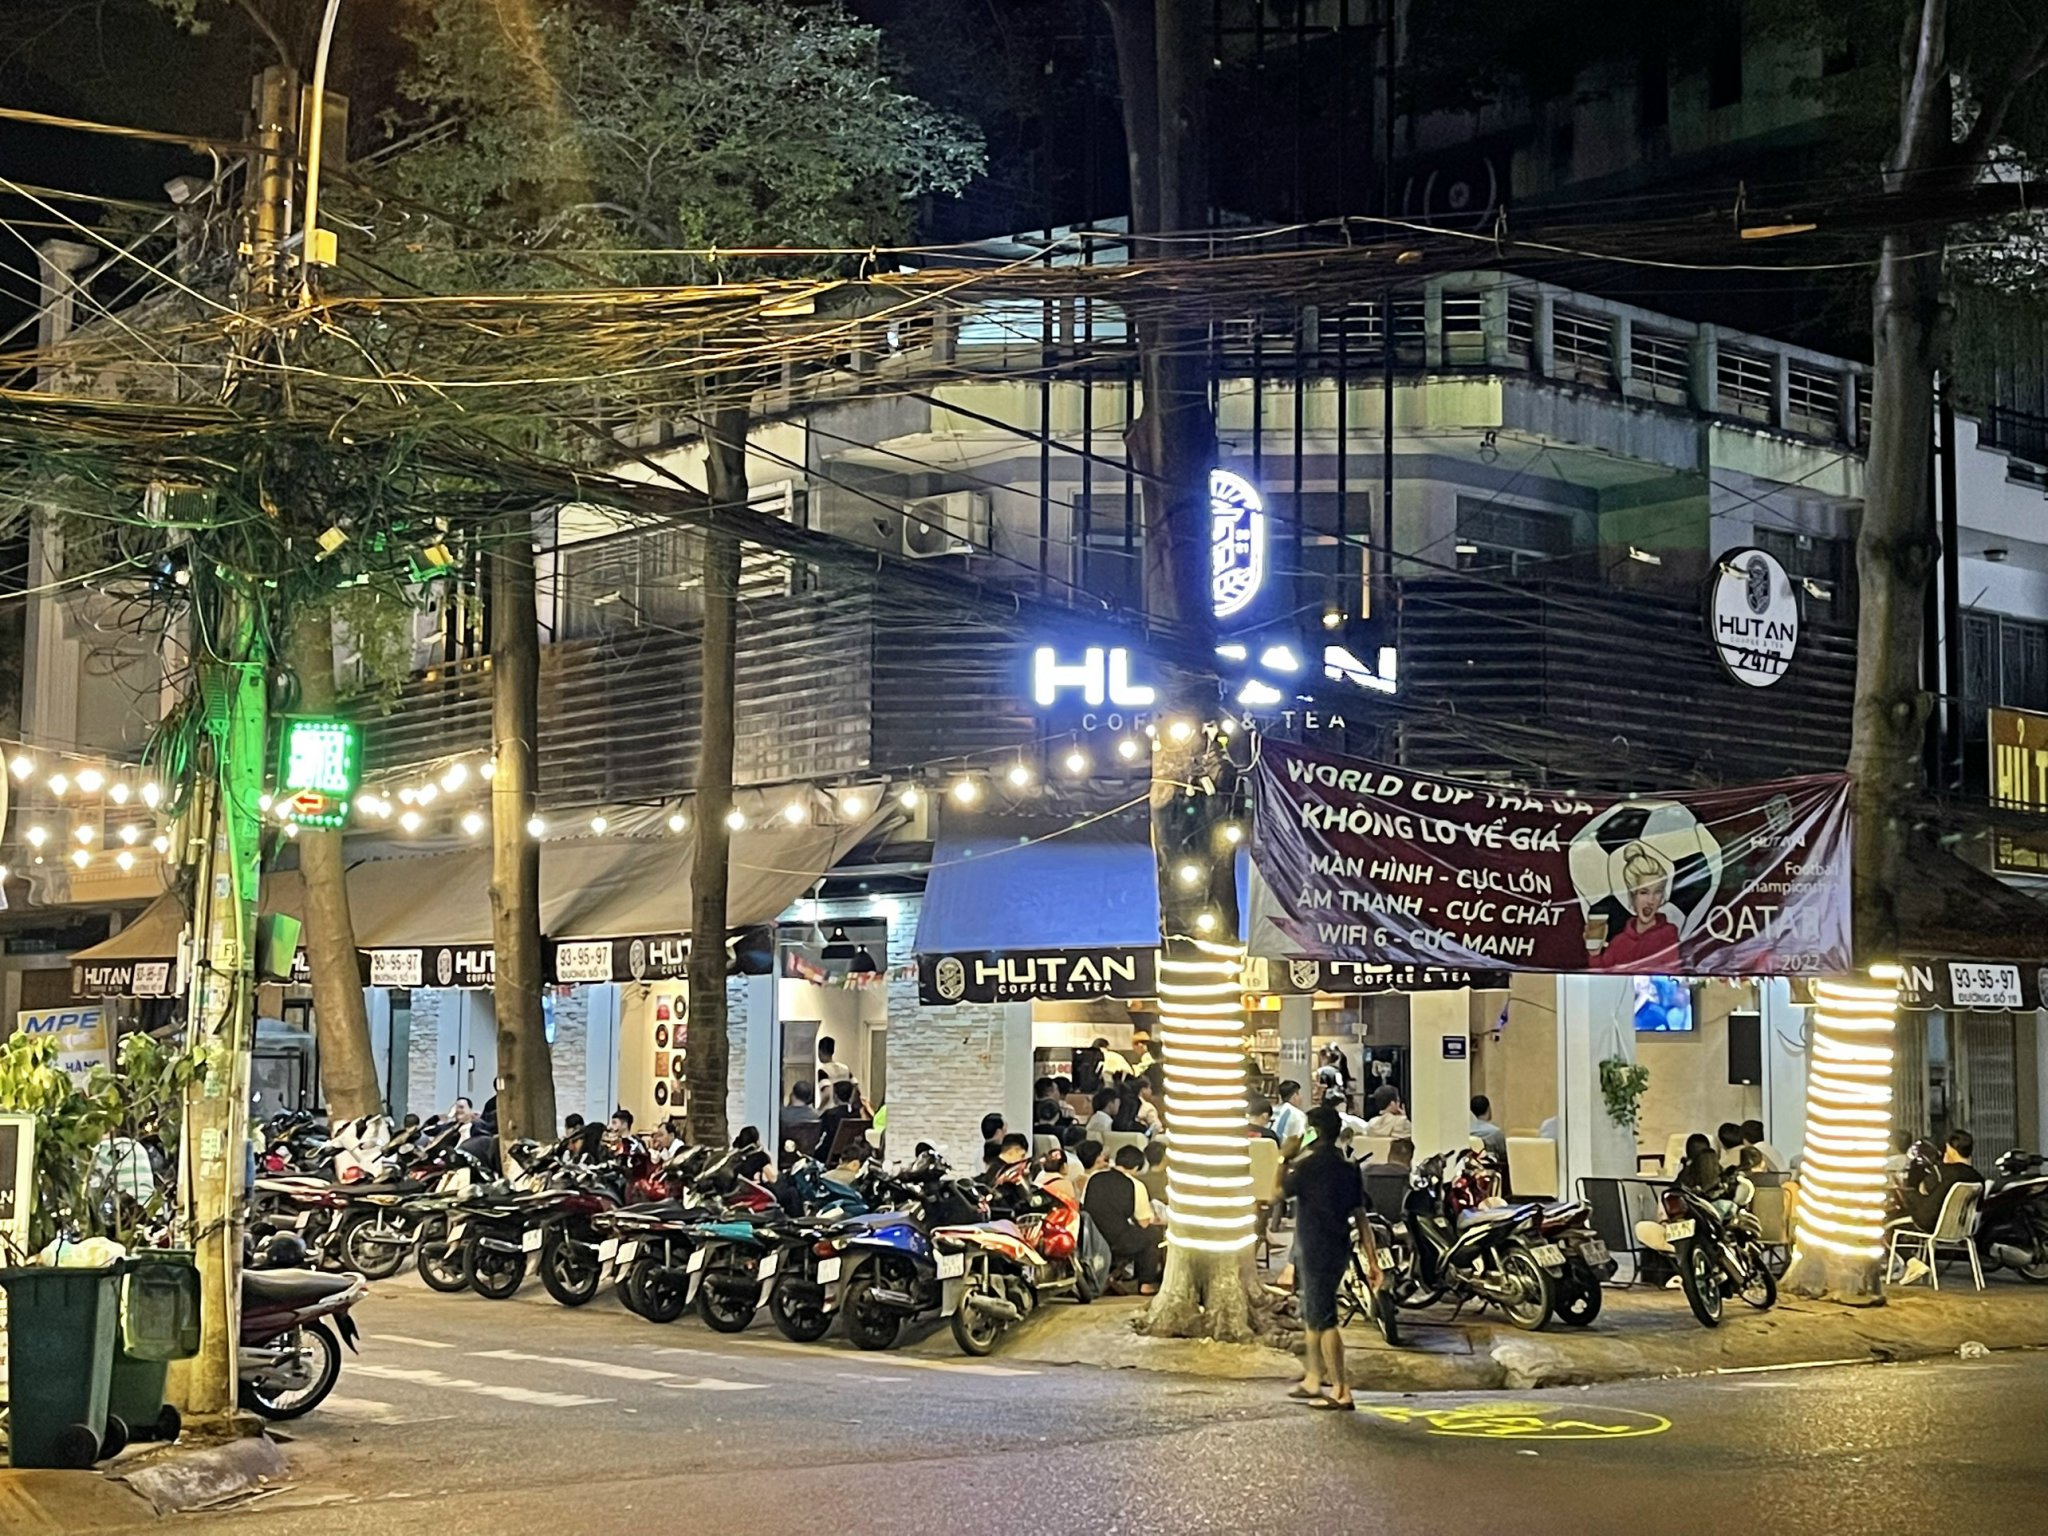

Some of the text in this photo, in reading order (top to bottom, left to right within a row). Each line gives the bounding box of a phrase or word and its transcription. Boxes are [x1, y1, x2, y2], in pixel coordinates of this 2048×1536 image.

[1718, 615, 1794, 642] HUTAN
[1281, 711, 1346, 730] TEA
[1286, 757, 1404, 797] WORLD
[1411, 781, 1475, 806] CUP
[1301, 802, 1415, 840] KHÔNG
[1419, 818, 1457, 845] LO
[1509, 822, 1562, 853] GIÁ
[1310, 849, 1365, 879] MÀN
[1369, 855, 1434, 885] HÌNH
[1456, 867, 1503, 895] CỰC
[1507, 867, 1553, 895] LỚN
[1296, 882, 1333, 910] ÂM
[1338, 889, 1424, 916] THANH
[1445, 899, 1497, 926] CỰC
[1501, 898, 1566, 926] CHẤT
[1317, 922, 1368, 946] WIFI
[1373, 926, 1389, 947] 6
[455, 950, 496, 974] HUT
[975, 955, 1136, 985] HUTAN
[1781, 953, 1821, 972] 2022
[84, 967, 132, 985] HUTAN
[998, 980, 1112, 995] COFFEE & TEA
[1354, 971, 1471, 986] COFFEE & TEA
[24, 1012, 101, 1034] MPE
